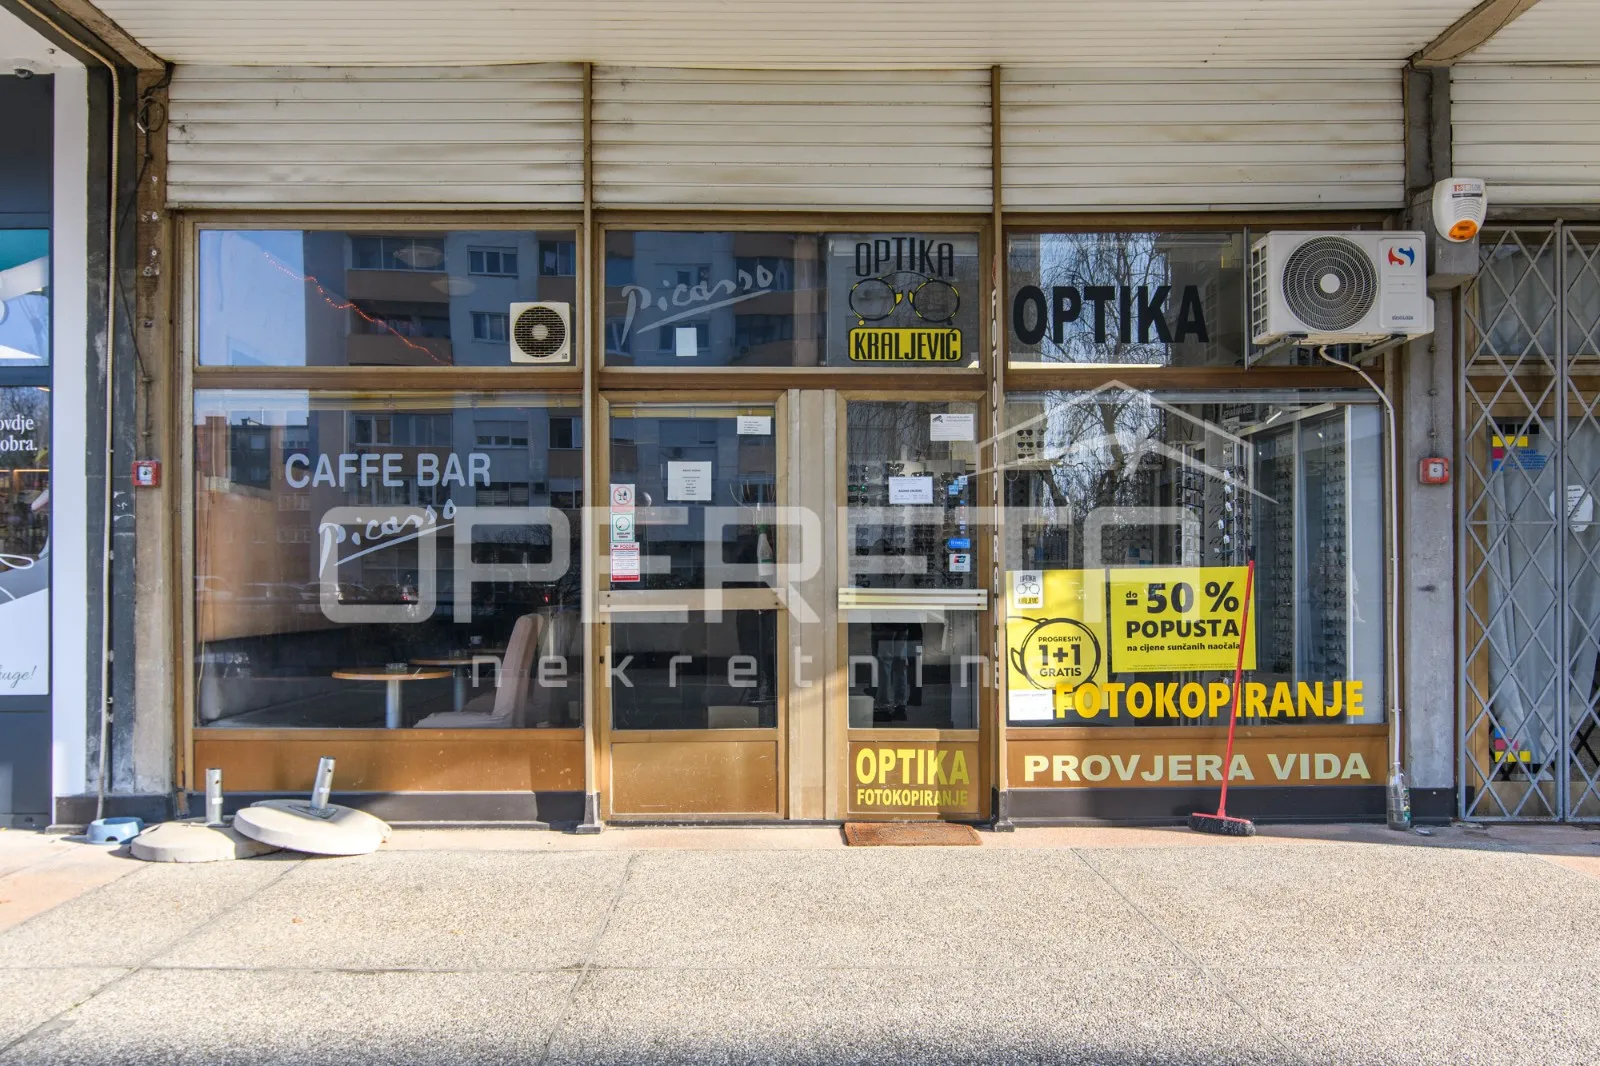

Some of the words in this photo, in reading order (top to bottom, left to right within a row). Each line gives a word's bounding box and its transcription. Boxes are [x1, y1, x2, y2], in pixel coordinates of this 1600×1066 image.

[855, 237, 954, 277] OPTIKA
[1012, 284, 1209, 345] OPTIKA
[854, 328, 958, 360] KRALJEVIĆ
[285, 453, 404, 489] CAFFE
[417, 453, 491, 487] BAR
[1126, 590, 1138, 599] do
[1037, 635, 1082, 643] PROGRESIVI
[1126, 619, 1240, 638] POPUSTA
[1038, 644, 1081, 666] 1+1
[1127, 643, 1138, 652] na
[1139, 643, 1165, 654] cijene
[1167, 642, 1206, 652] sunčanih
[1207, 640, 1240, 651] naočala
[1039, 667, 1082, 678] GRATIS
[1055, 680, 1365, 719] FOTOKOPIRANJE
[855, 747, 970, 785] OPTIKA
[1024, 754, 1255, 782] PROVJERA
[1267, 752, 1371, 780] VIDA
[857, 789, 969, 807] FOTOKOPIRANJE
